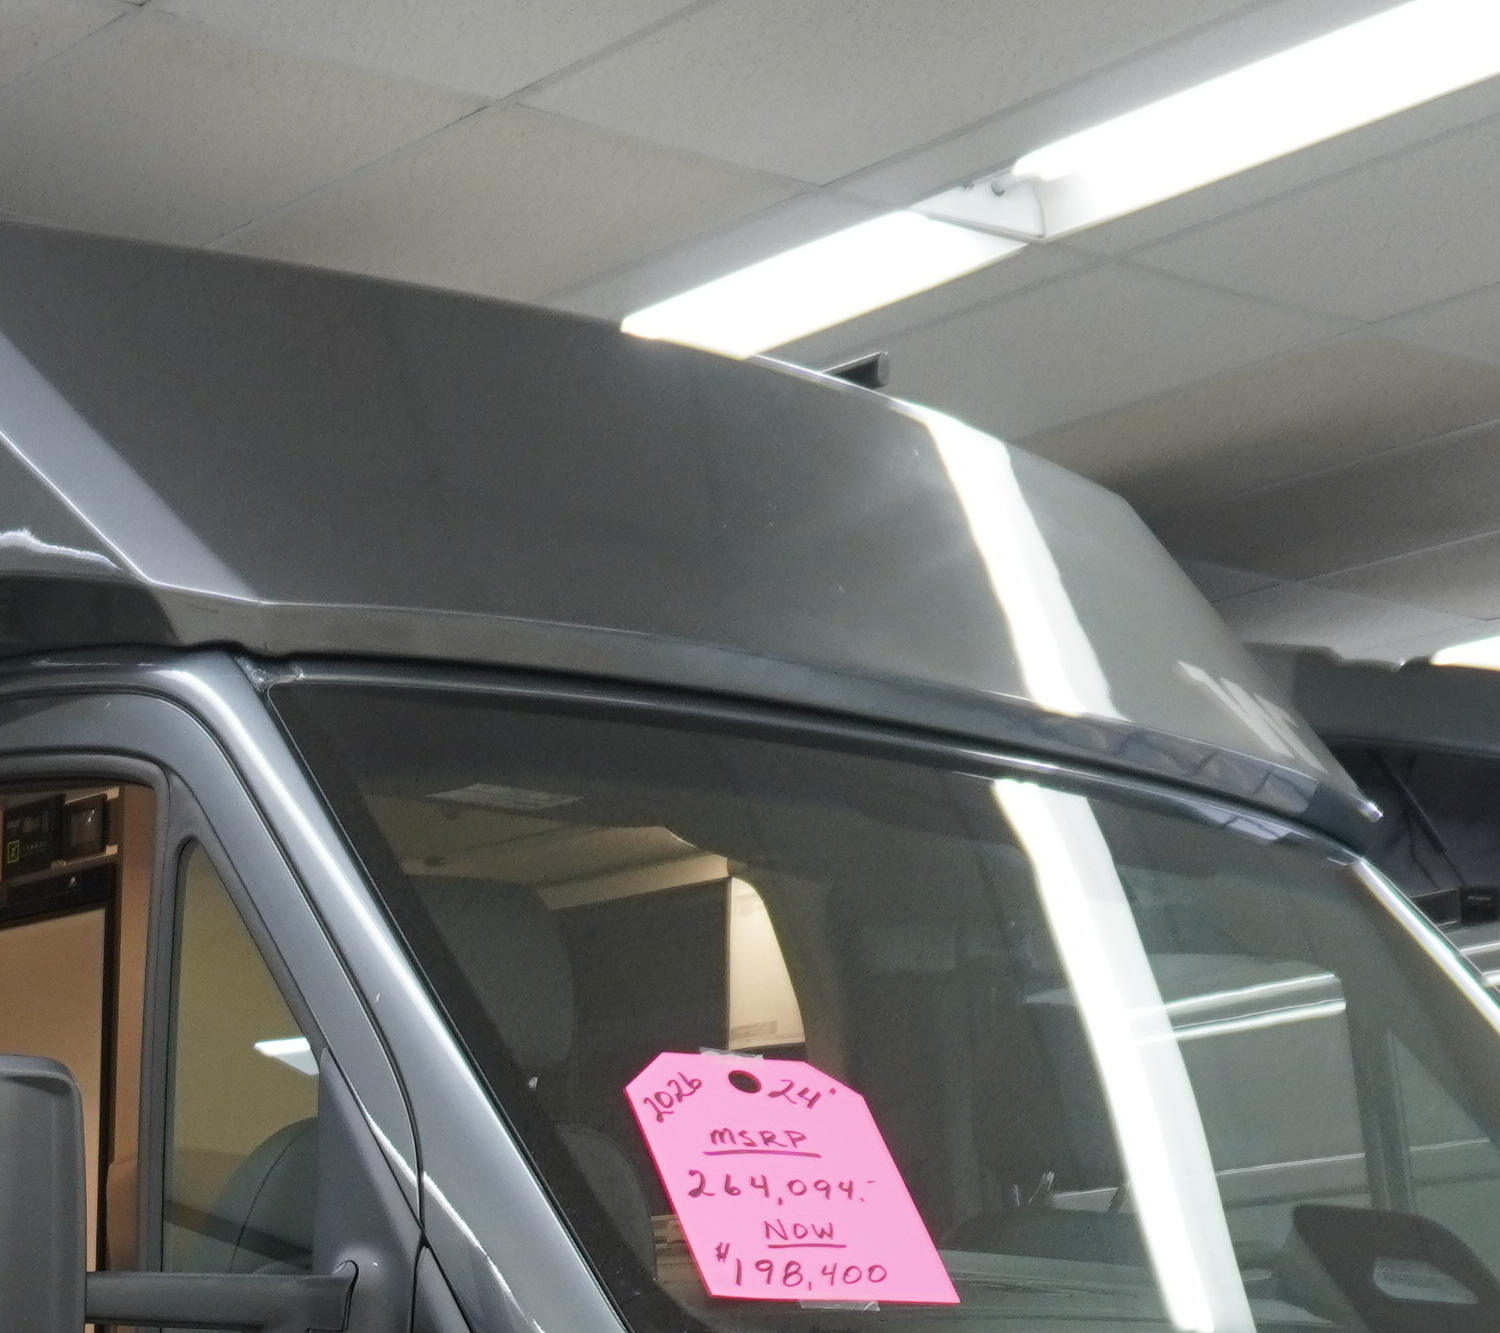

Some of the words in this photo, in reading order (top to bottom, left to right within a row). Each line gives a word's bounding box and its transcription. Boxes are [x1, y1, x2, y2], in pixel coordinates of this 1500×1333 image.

[643, 1071, 702, 1122] 2026
[710, 1128, 807, 1149] MSRP
[764, 1218, 834, 1241] NOW
